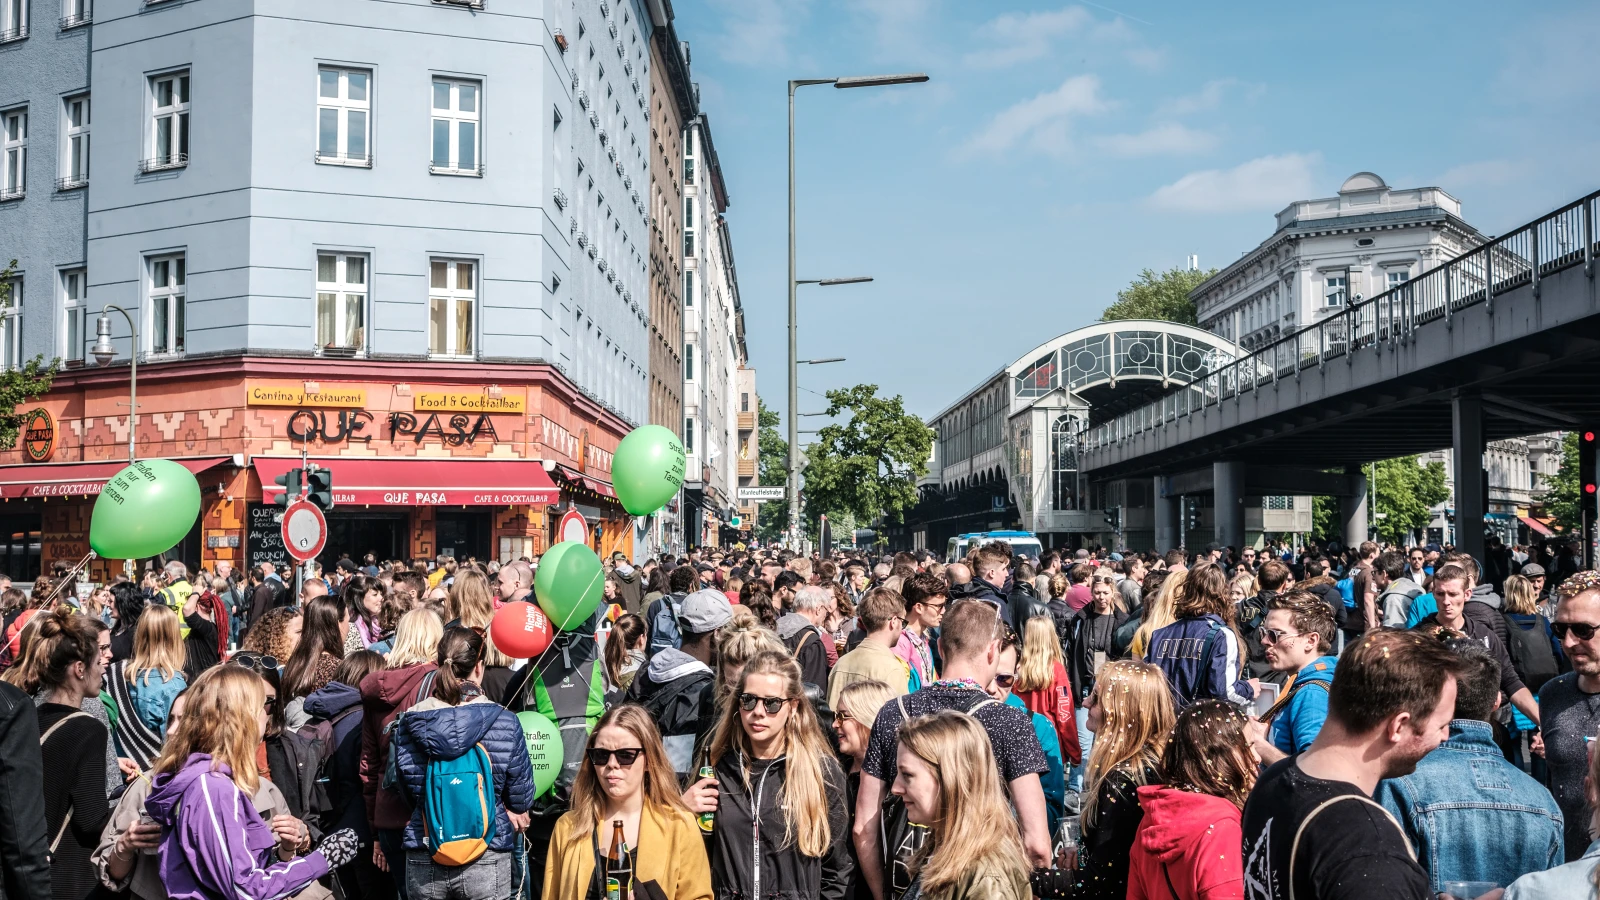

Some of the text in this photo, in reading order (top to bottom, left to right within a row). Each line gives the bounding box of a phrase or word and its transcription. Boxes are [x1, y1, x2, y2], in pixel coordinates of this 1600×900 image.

[253, 388, 362, 404] Cantina y Restaurant
[420, 395, 521, 409] Food & Cocktailbar
[287, 409, 500, 447] QUE PASA
[124, 471, 140, 482] nur
[114, 477, 130, 492] zum
[32, 486, 50, 496] CAFE
[740, 489, 782, 497] Manteuffelstraße
[384, 492, 447, 504] QUE PASA
[474, 495, 492, 503] CAFE
[501, 495, 548, 503] COCKTAILBAR
[995, 496, 1004, 508] U
[253, 551, 285, 559] BRUNCH
[1056, 686, 1071, 722] FILA
[531, 743, 545, 751] nur
[532, 763, 550, 771] nzen
